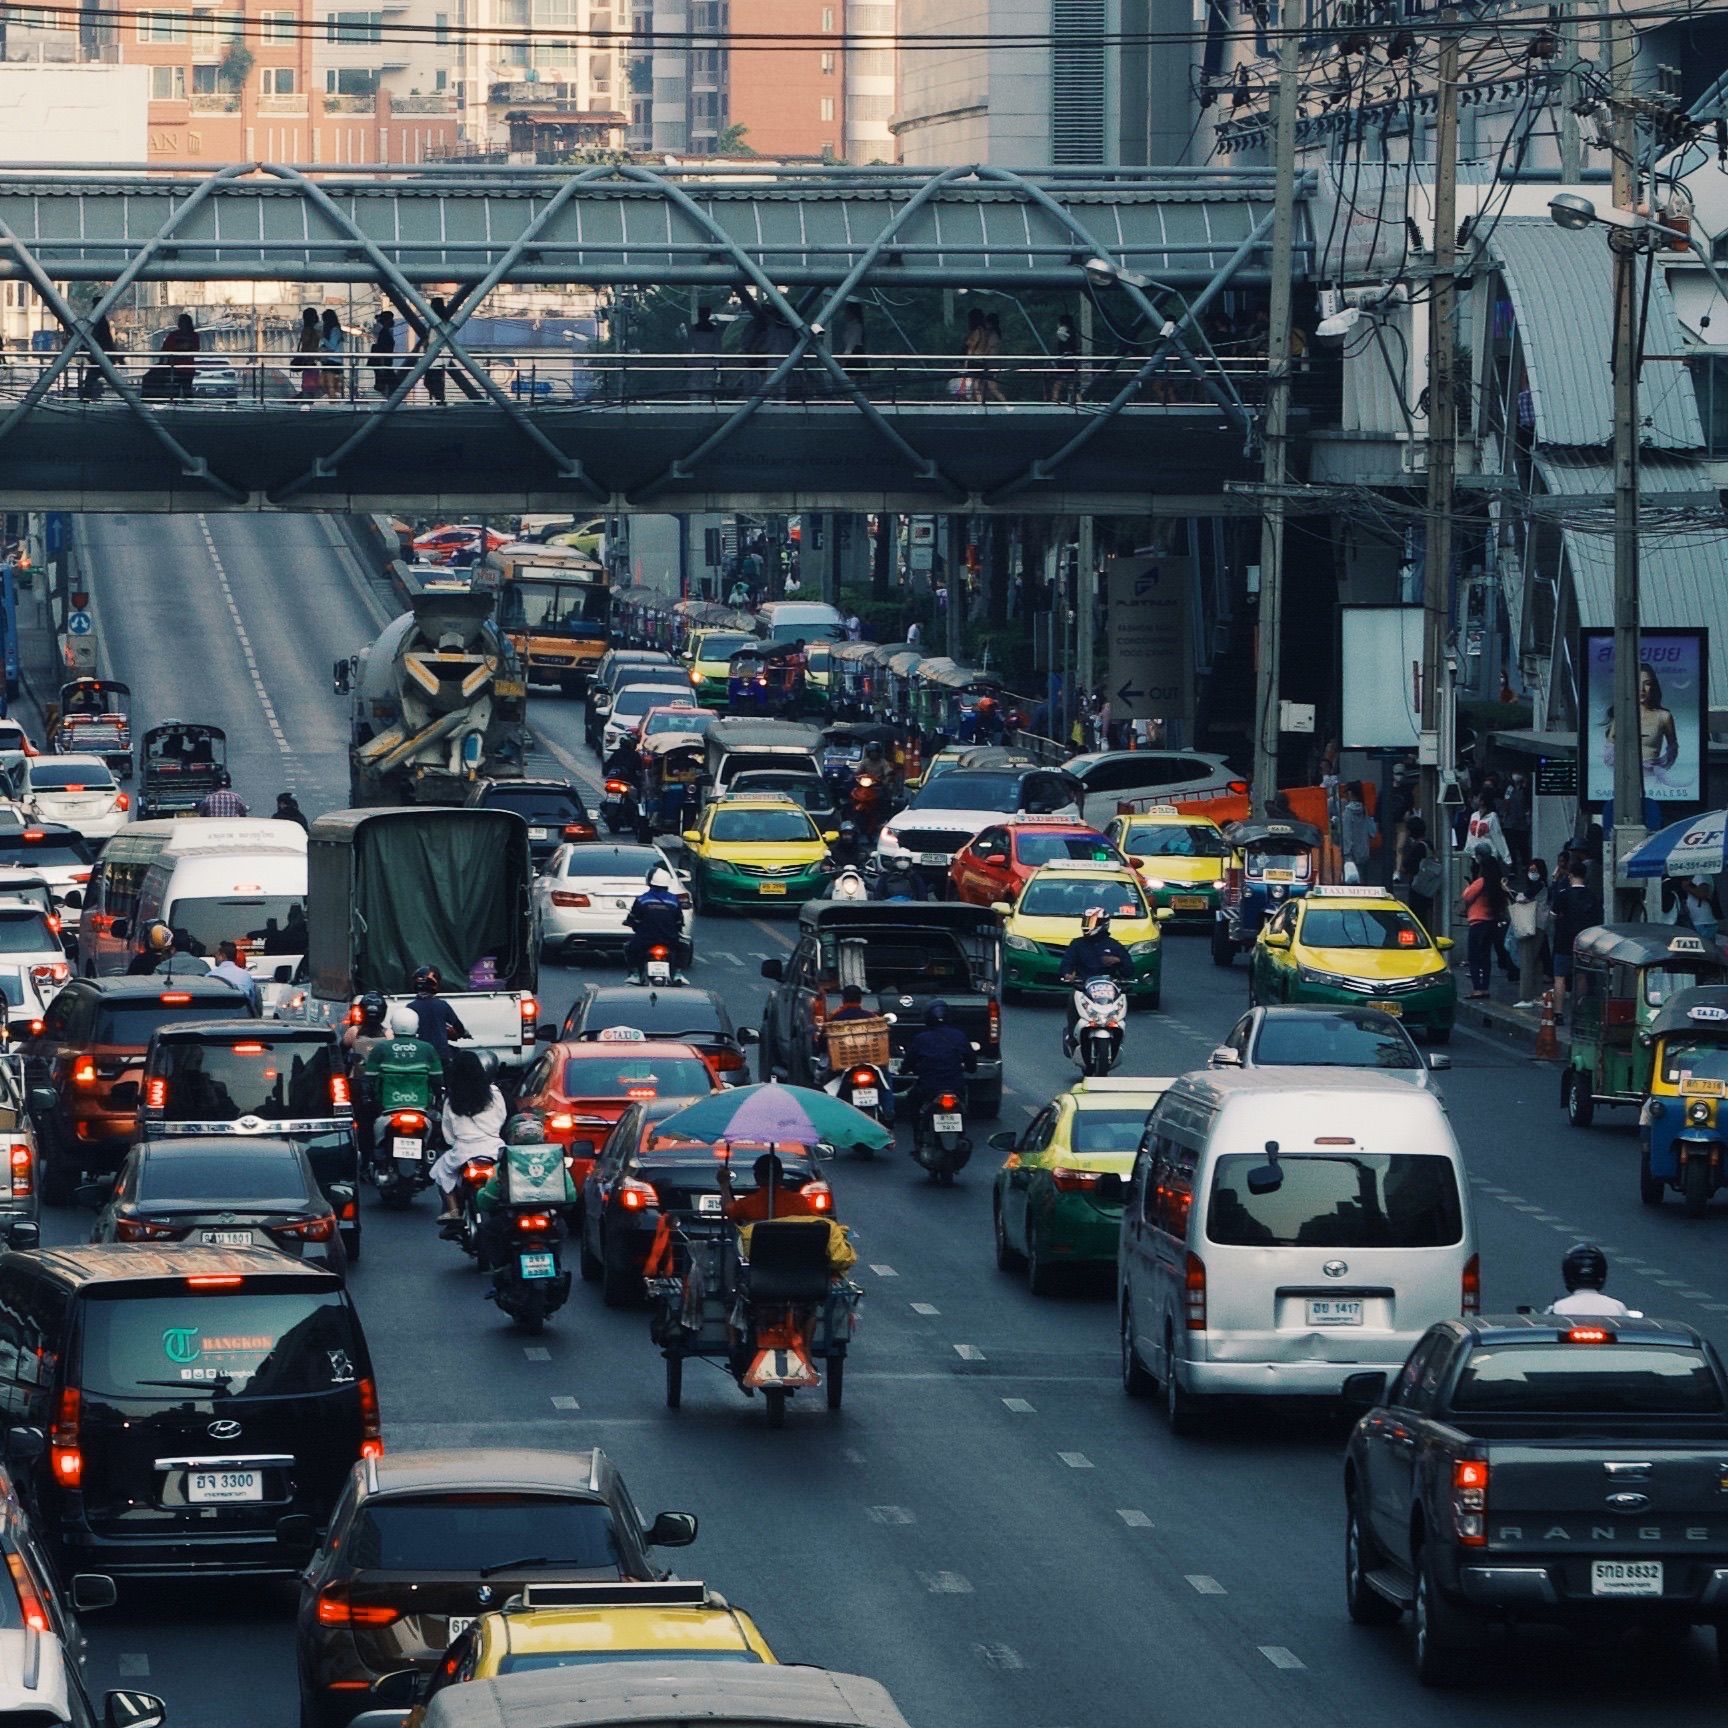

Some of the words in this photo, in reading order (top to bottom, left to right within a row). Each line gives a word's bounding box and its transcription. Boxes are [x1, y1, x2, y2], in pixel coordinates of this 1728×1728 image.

[1149, 686, 1179, 700] OUT
[1647, 789, 1688, 798] RALESS
[1683, 831, 1724, 846] GF
[1324, 887, 1345, 895] TAXI
[1349, 887, 1380, 896] METER
[1676, 939, 1699, 949] TAXI
[392, 1043, 417, 1052] Grab
[392, 1091, 418, 1102] Grab
[202, 1337, 273, 1351] BANGKOK
[221, 1474, 254, 1488] 3300
